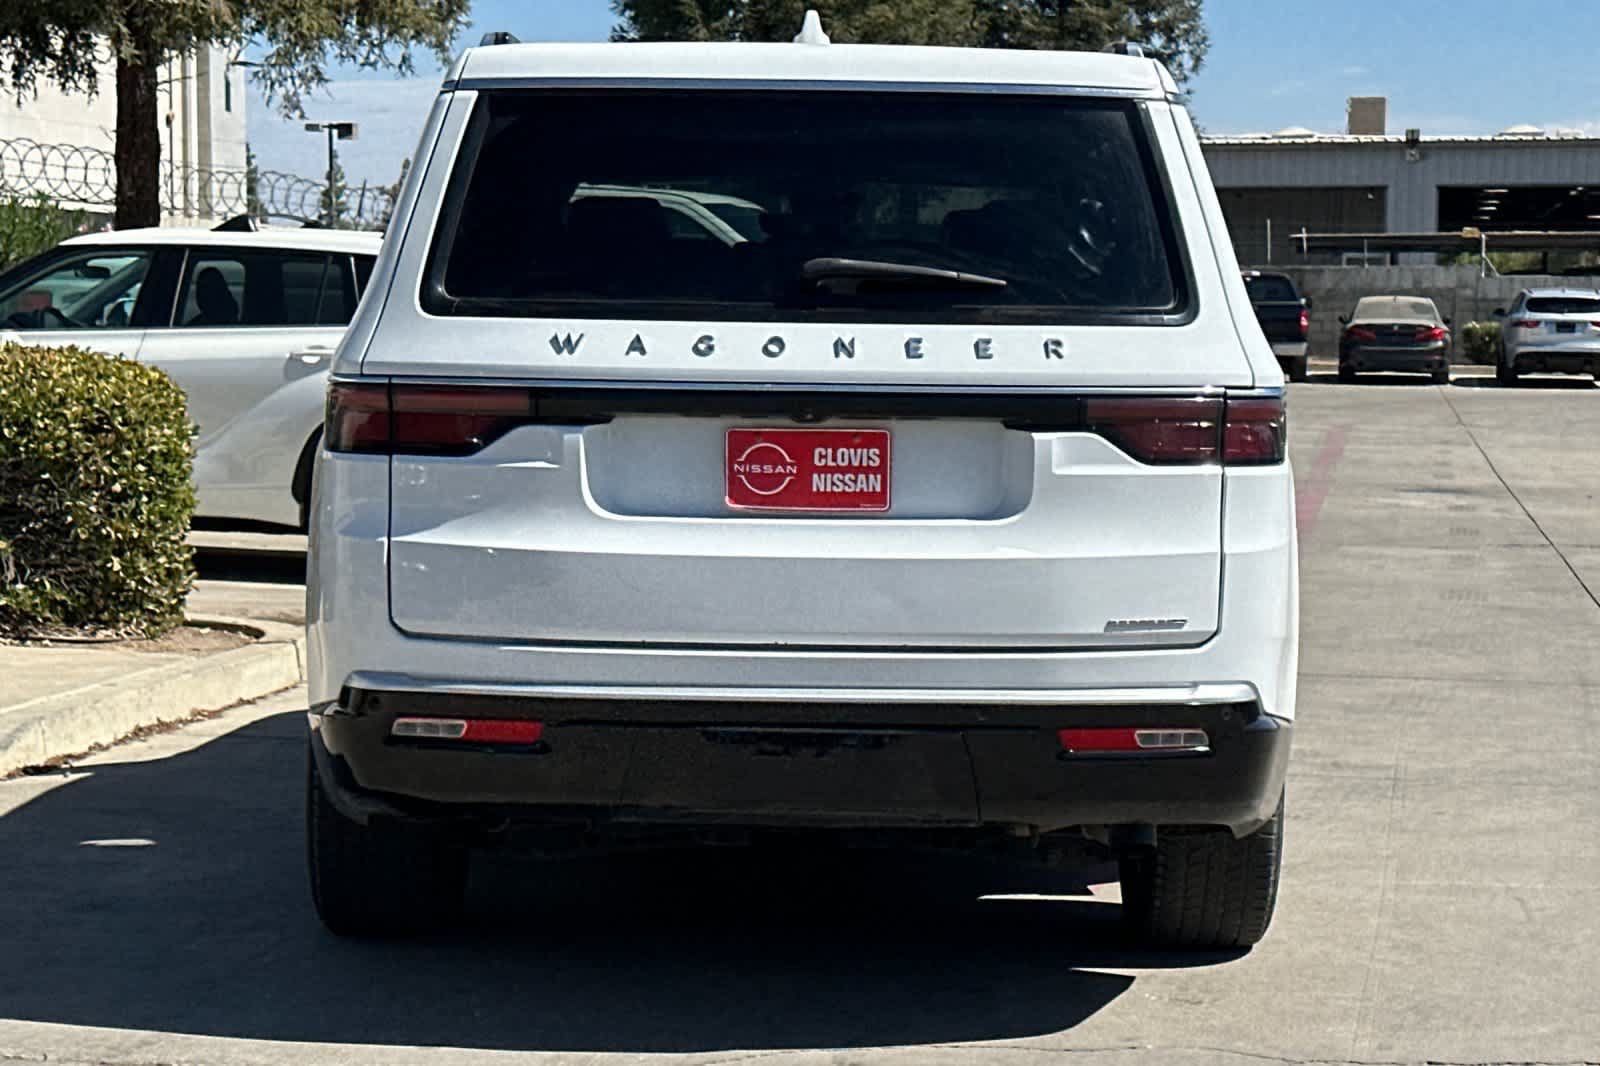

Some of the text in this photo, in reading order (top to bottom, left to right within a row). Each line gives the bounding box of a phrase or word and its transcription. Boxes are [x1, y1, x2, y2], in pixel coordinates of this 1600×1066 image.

[549, 332, 1065, 360] WAGONEER
[813, 447, 881, 467] CLOVIS
[734, 463, 798, 474] NISSAN
[812, 473, 882, 492] NISSAN
